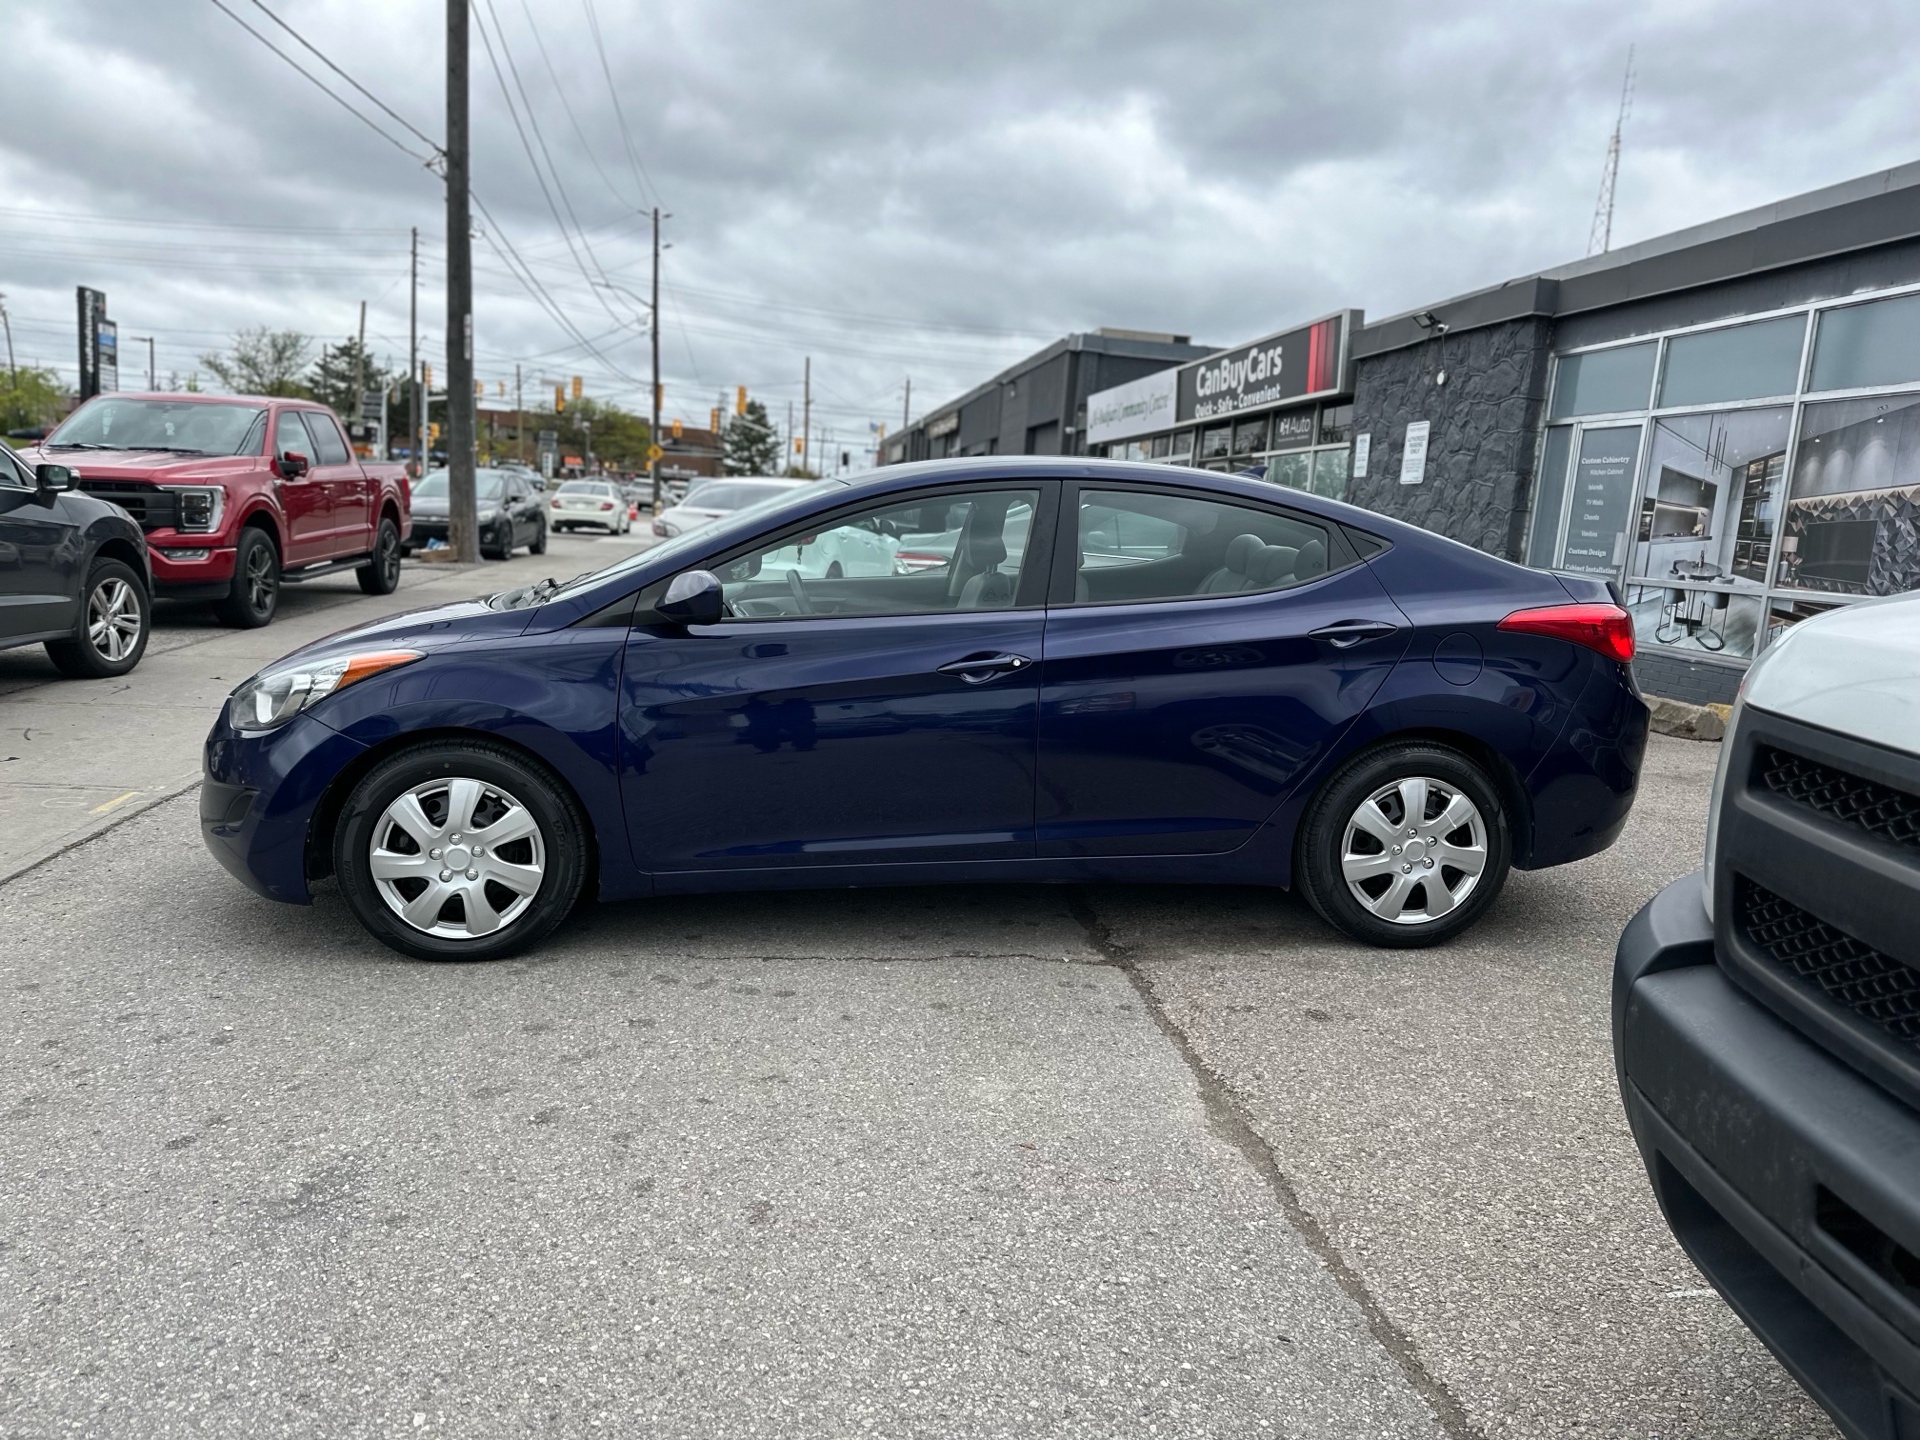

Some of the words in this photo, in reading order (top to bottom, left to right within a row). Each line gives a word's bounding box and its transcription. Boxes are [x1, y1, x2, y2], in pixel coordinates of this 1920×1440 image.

[1196, 346, 1282, 397] CanBuyCars
[1195, 400, 1213, 419] Quick
[1218, 395, 1233, 414] Safe
[1238, 383, 1280, 408] Convenient
[1290, 416, 1310, 433] Auto
[1602, 456, 1630, 464] Cabinetry
[1583, 513, 1600, 521] Closets
[1568, 547, 1588, 555] Custom
[1588, 548, 1607, 558] Design
[1565, 563, 1585, 572] Cabinet
[1585, 565, 1617, 575] Installation
